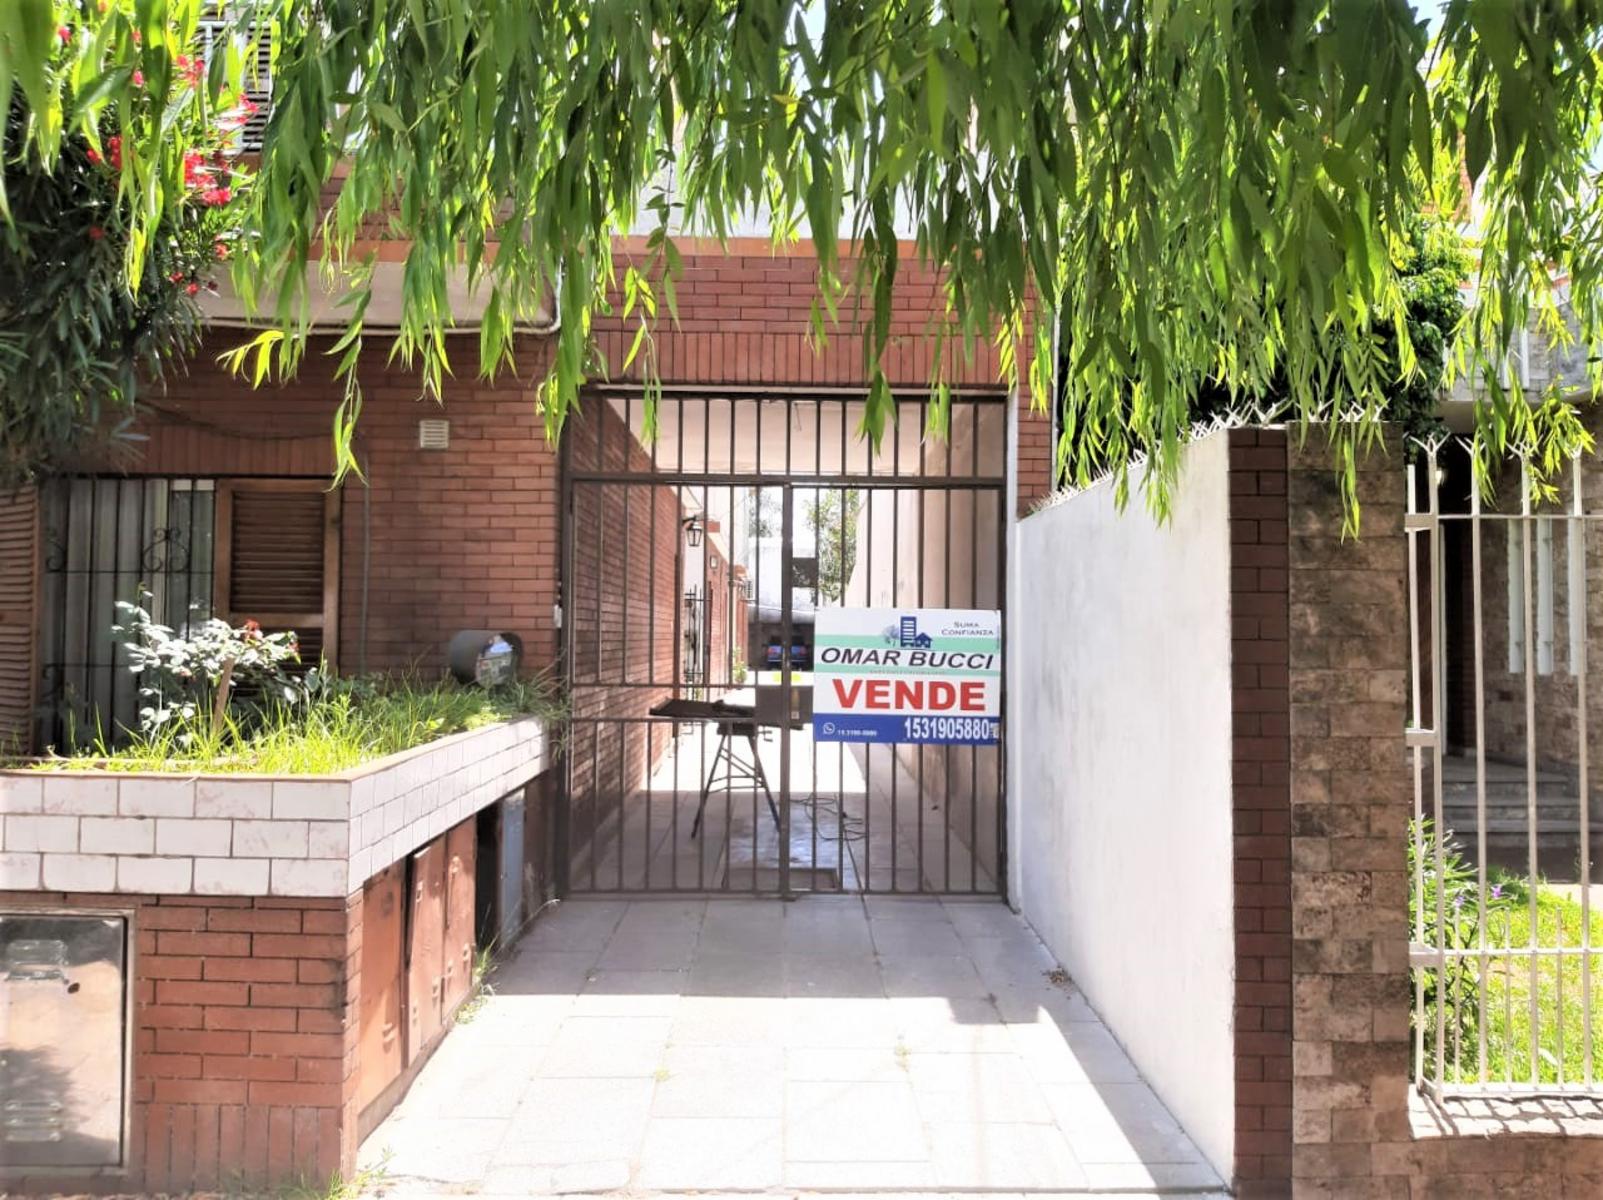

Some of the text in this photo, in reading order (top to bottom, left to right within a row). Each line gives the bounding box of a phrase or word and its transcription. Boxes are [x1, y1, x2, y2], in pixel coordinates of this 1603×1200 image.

[821, 647, 994, 669] OMAR BUCCI
[832, 678, 986, 711] VENDE
[904, 717, 990, 740] 1531905880
